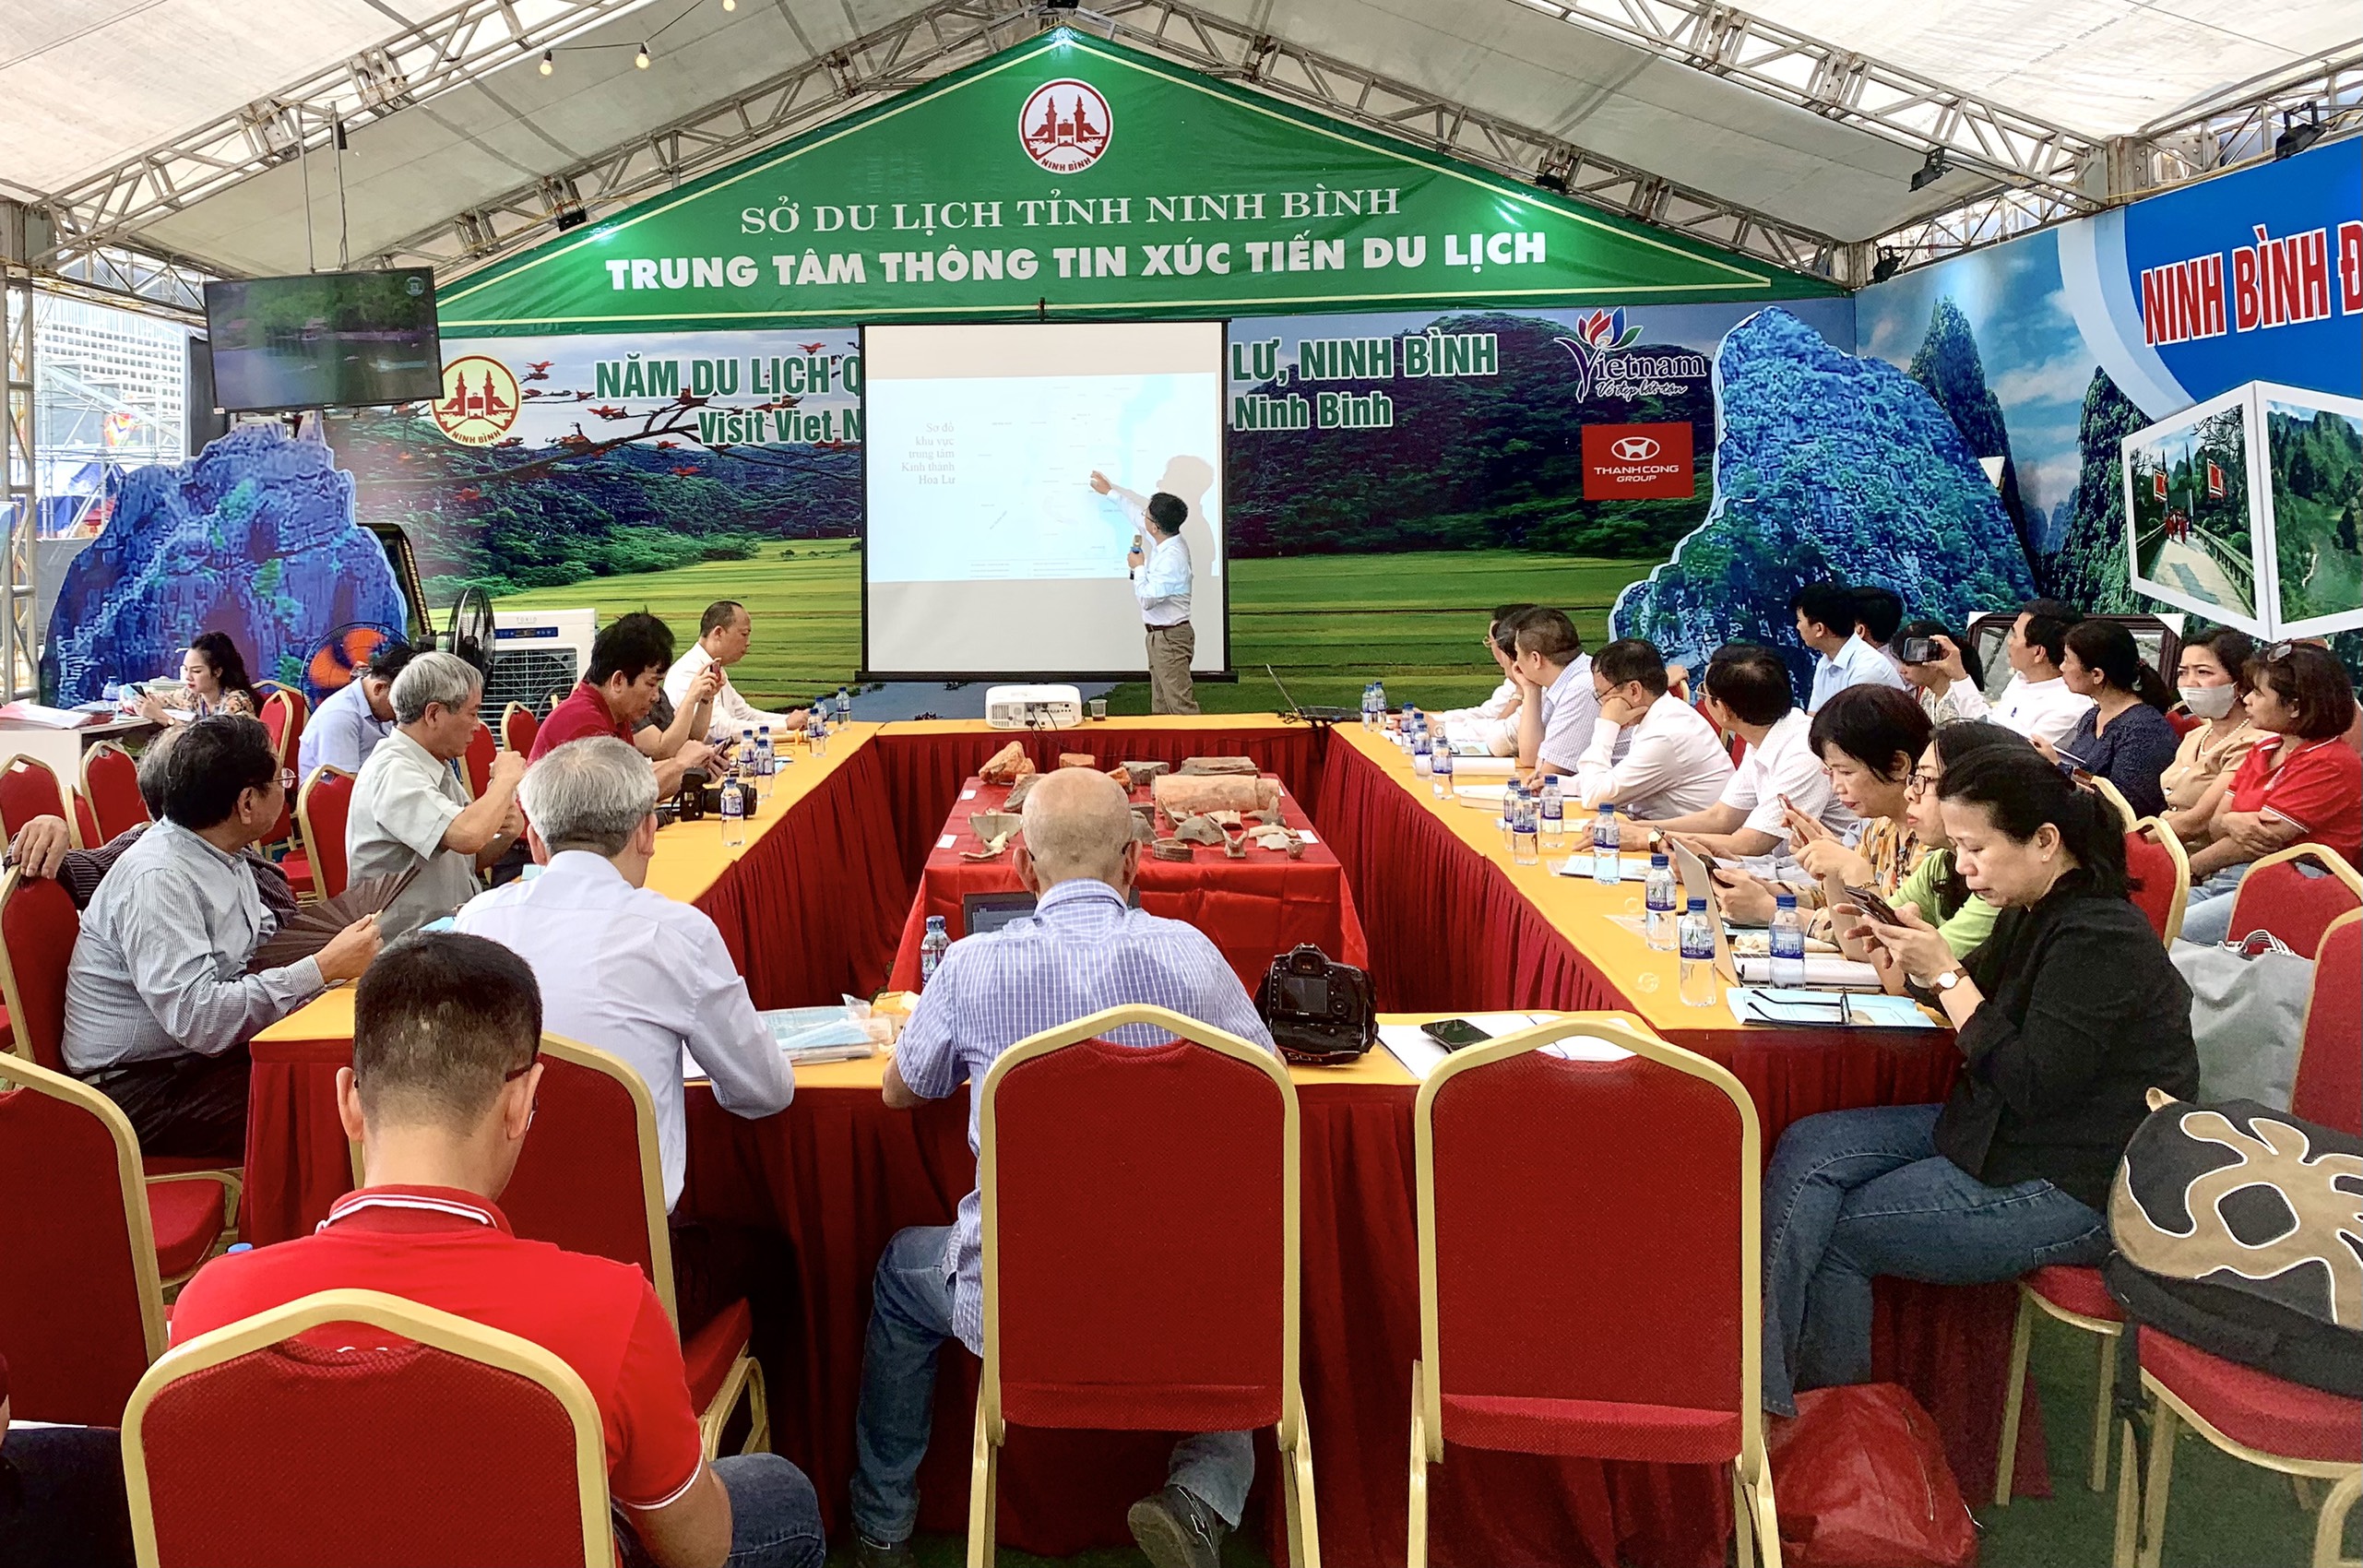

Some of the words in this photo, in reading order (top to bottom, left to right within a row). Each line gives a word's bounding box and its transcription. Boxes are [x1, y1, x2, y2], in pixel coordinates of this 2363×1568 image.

[1041, 158, 1066, 172] NINH
[1068, 157, 1092, 172] BÌNH
[741, 195, 801, 234] SỞ
[813, 204, 879, 232] DU
[892, 201, 1003, 237] LỊCH
[1016, 188, 1133, 227] TỈNH
[1146, 193, 1267, 224] NINH
[1280, 183, 1401, 219] BÌNH
[605, 255, 759, 291] TRUNG
[772, 247, 867, 286] TÂM
[879, 244, 1039, 283] THÔNG
[1052, 245, 1126, 279] TIN
[1141, 237, 1230, 277] XÚC
[1245, 230, 1346, 273] TIẾN
[1363, 235, 1427, 269] DU
[1444, 232, 1547, 274] LỊCH
[2142, 254, 2227, 346] NINH
[2234, 225, 2330, 330] BÌNH
[596, 352, 679, 398] NĂM
[692, 358, 739, 397] DU
[751, 356, 830, 403] LỊCH
[1232, 338, 1288, 385] LƯ,
[1299, 338, 1393, 379] NINH
[1405, 327, 1498, 378] BÌNH
[1553, 337, 1707, 404] Vietnam
[697, 410, 766, 445] Visit
[774, 409, 833, 442] Viet
[1234, 393, 1309, 430] Ninh
[1319, 391, 1392, 427] Binh
[451, 430, 476, 444] NINH
[477, 430, 502, 444] BÌNH
[915, 435, 934, 445] khu
[900, 462, 925, 472] Kinh
[908, 450, 934, 460] trung
[918, 474, 939, 484] Hoa
